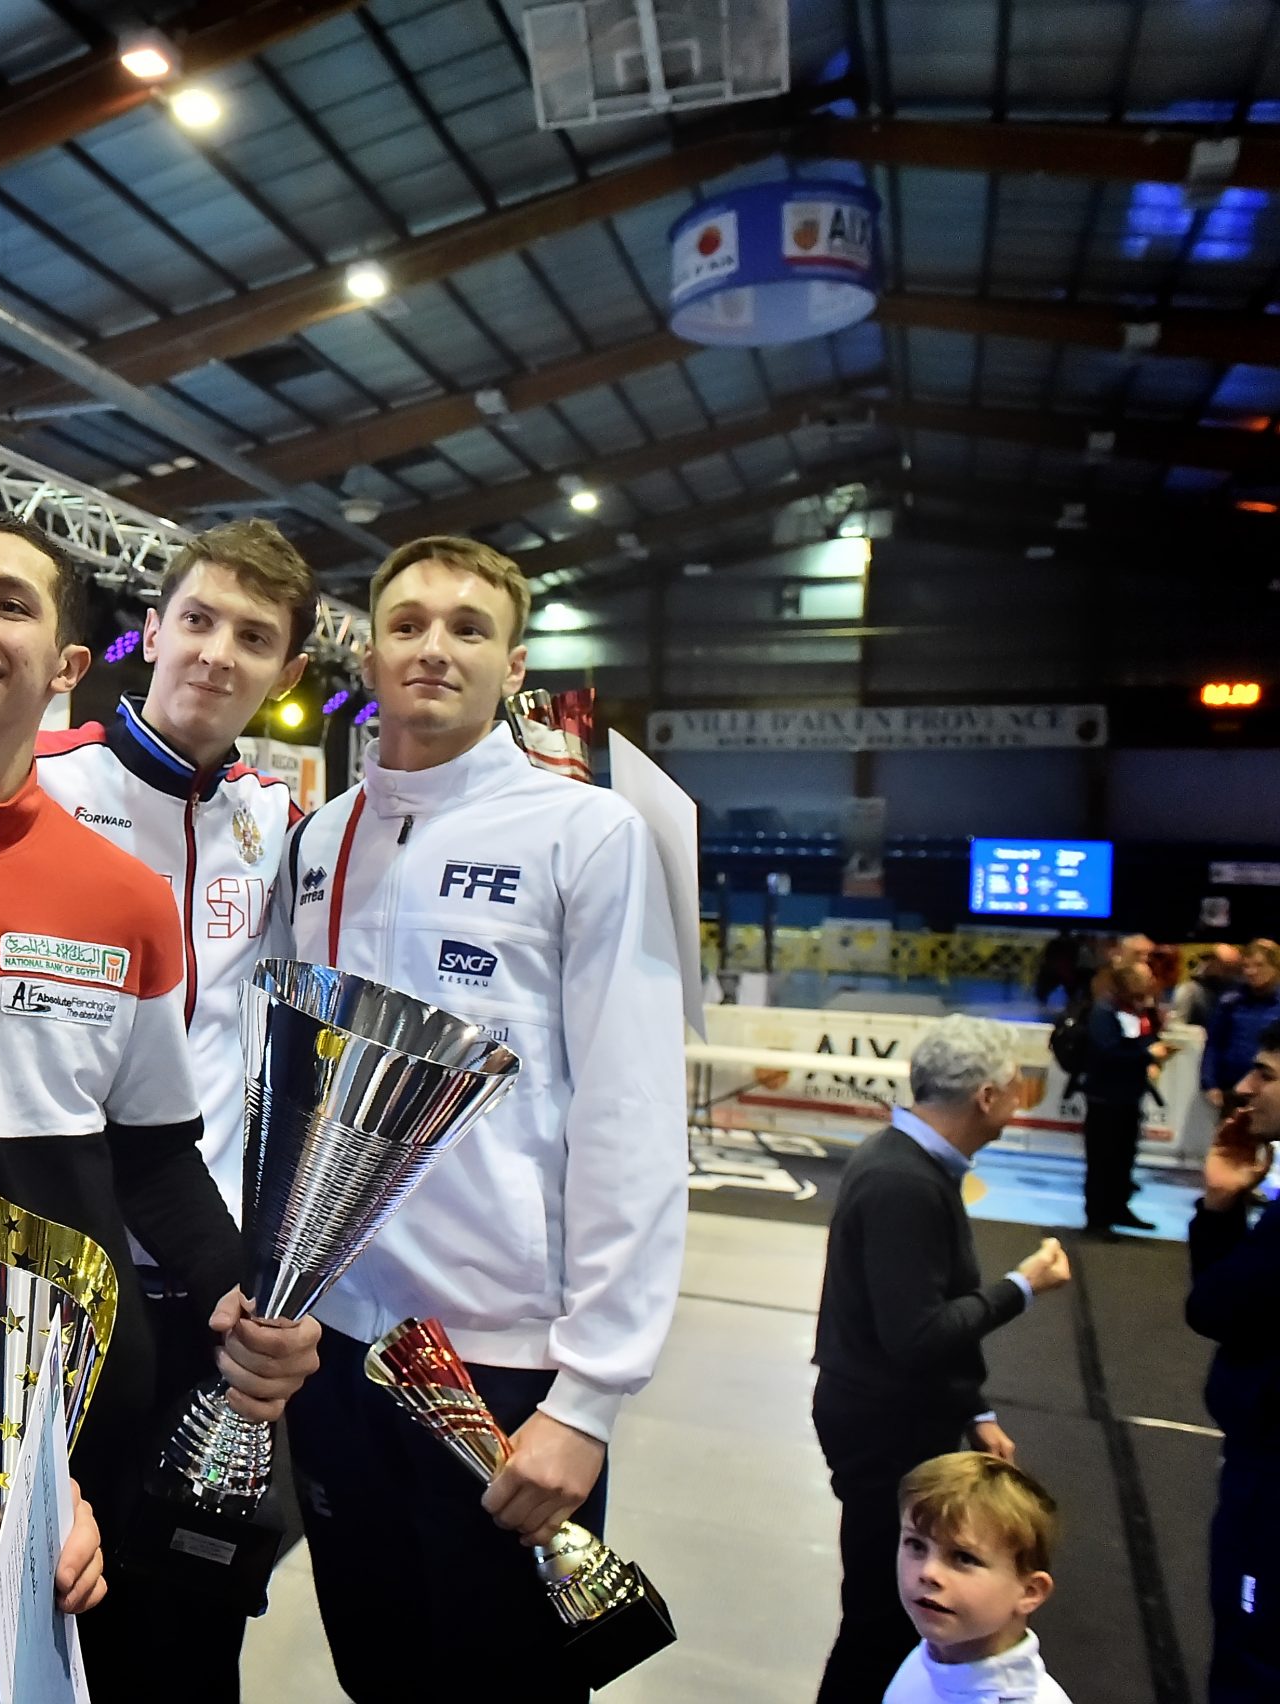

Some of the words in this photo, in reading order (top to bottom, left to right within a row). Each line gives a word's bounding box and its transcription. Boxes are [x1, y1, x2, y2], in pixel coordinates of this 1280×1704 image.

[439, 863, 522, 905] FFE
[5, 957, 44, 968] NATIONAL
[45, 961, 63, 972] BANK
[64, 965, 75, 974] OF
[76, 966, 101, 977] EGYPT
[440, 952, 495, 972] SNCF
[439, 975, 489, 988] RÉSEAU
